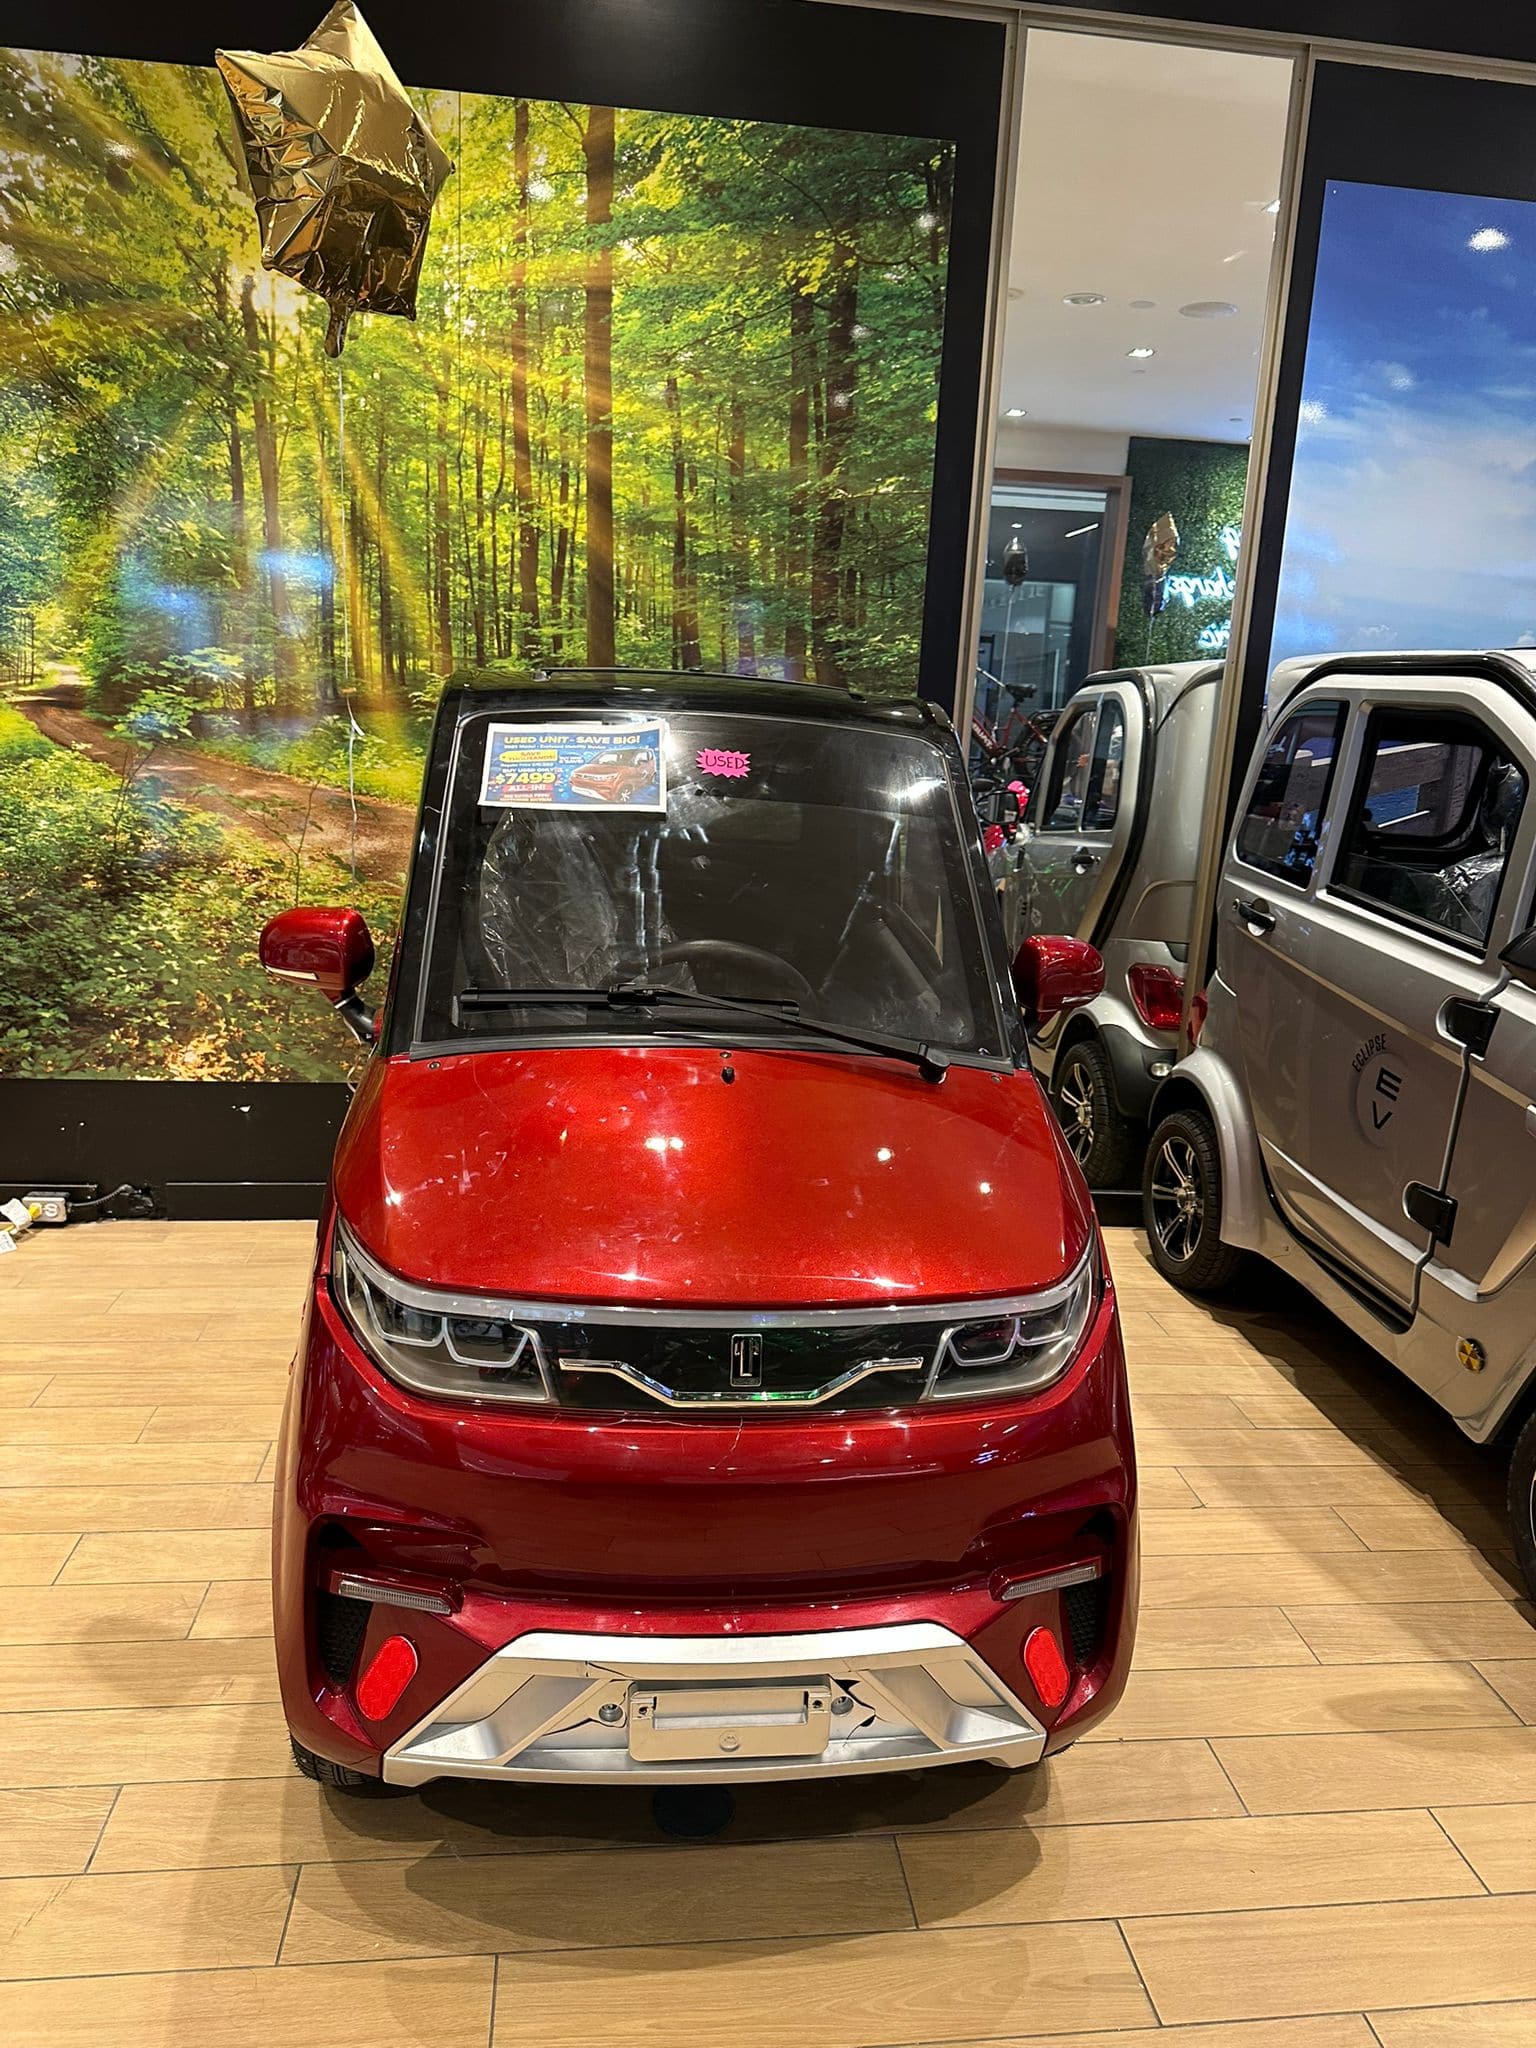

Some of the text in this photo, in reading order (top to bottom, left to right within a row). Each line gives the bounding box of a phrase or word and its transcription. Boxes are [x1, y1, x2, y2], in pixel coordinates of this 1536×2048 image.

[503, 736, 537, 744] USED
[576, 735, 610, 744] SAVE
[613, 735, 641, 744] BIG!
[705, 755, 745, 769] USED
[495, 772, 556, 785] $7499
[507, 784, 546, 792] ALL-IN!
[1351, 1033, 1387, 1073] ECLIPSE
